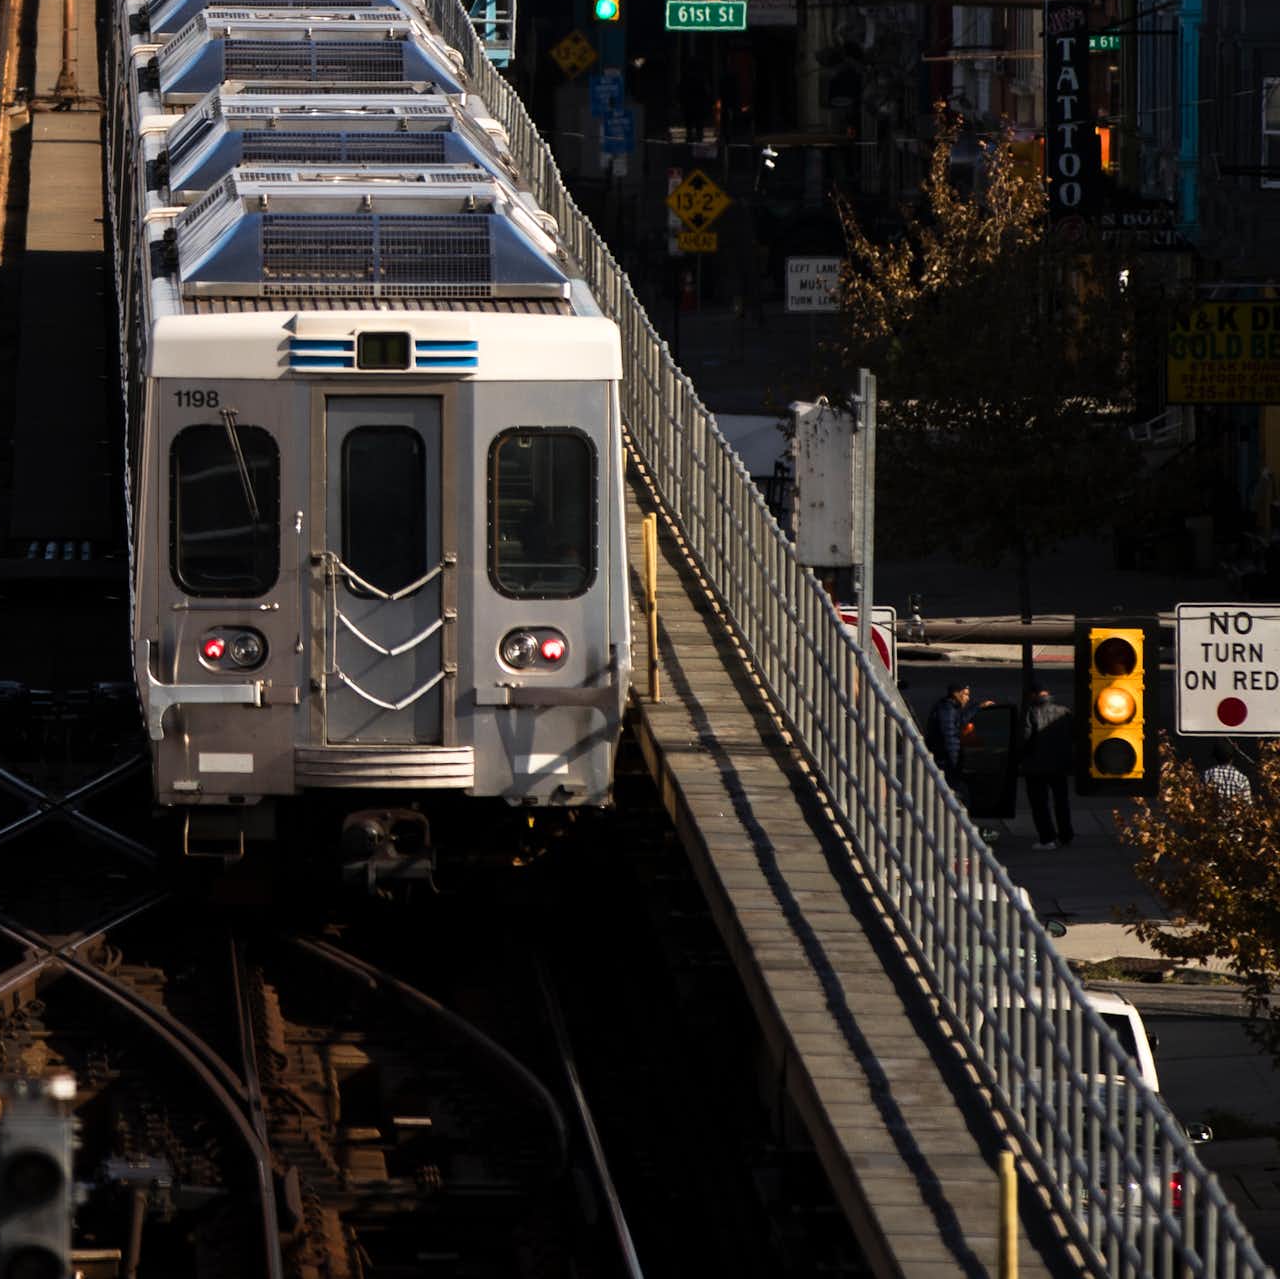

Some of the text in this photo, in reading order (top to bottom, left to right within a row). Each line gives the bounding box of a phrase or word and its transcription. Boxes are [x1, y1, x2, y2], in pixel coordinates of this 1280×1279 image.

[678, 6, 734, 23] 61st St
[1056, 37, 1081, 207] TATTOO
[789, 263, 810, 273] LEFT
[799, 279, 828, 290] MUST
[173, 390, 219, 408] 1198
[1210, 612, 1253, 635] NO
[1201, 643, 1263, 662] TURN
[1185, 670, 1279, 691] ON RED
